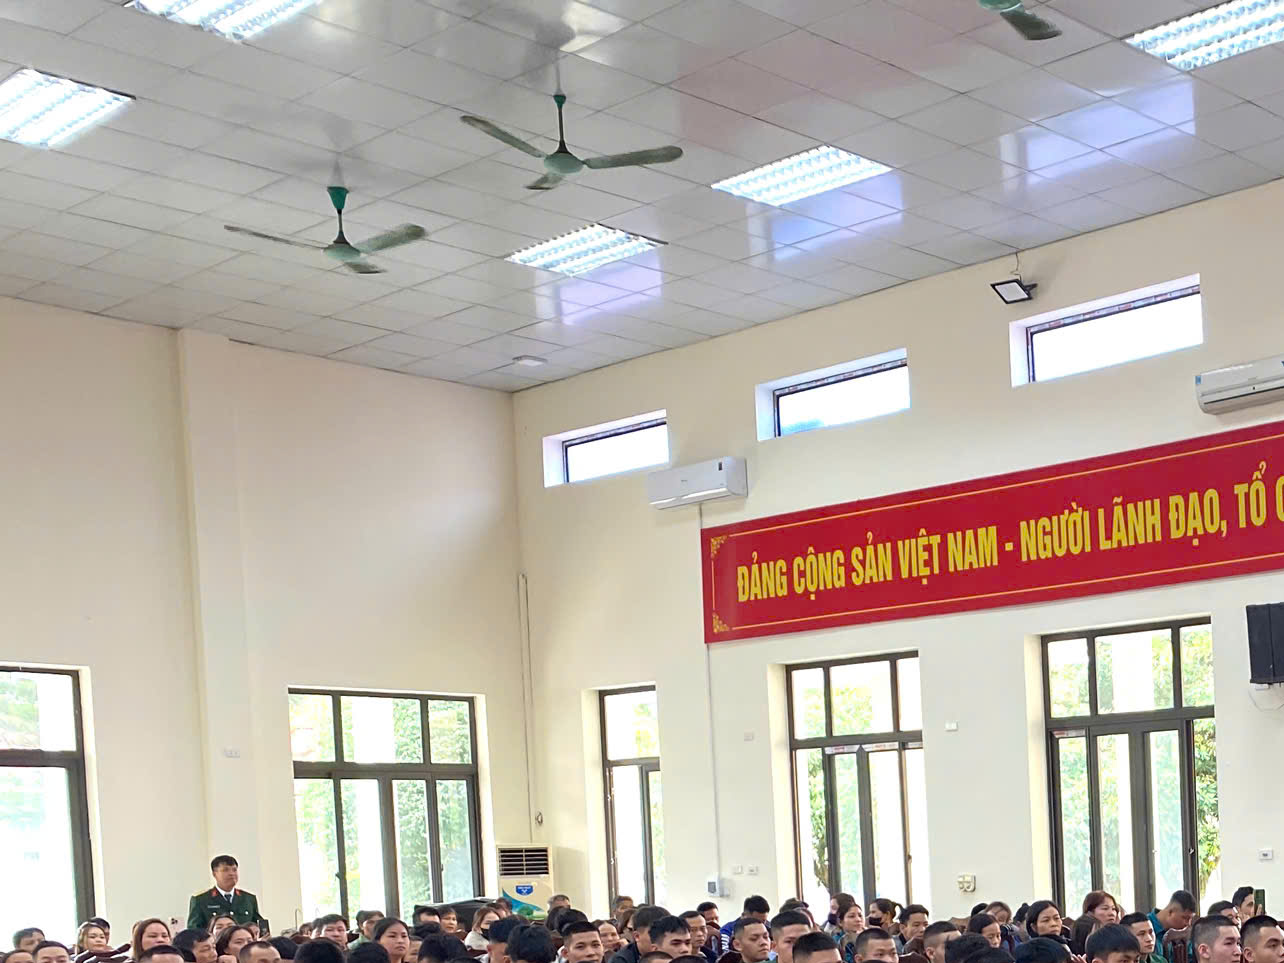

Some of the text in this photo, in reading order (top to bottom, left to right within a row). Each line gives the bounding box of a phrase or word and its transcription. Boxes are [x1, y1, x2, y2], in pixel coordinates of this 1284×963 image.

[737, 551, 788, 602] ĐẢNG
[792, 545, 846, 601] CỘNG
[851, 531, 893, 586] SẢN
[896, 528, 942, 586] VIỆT
[947, 525, 999, 574] NAM
[1004, 541, 1014, 552] -
[1019, 502, 1092, 561] NGƯỜI
[1097, 494, 1163, 550] LÃNH
[1168, 490, 1227, 546] ĐẠO,
[1234, 460, 1267, 528] TỔ
